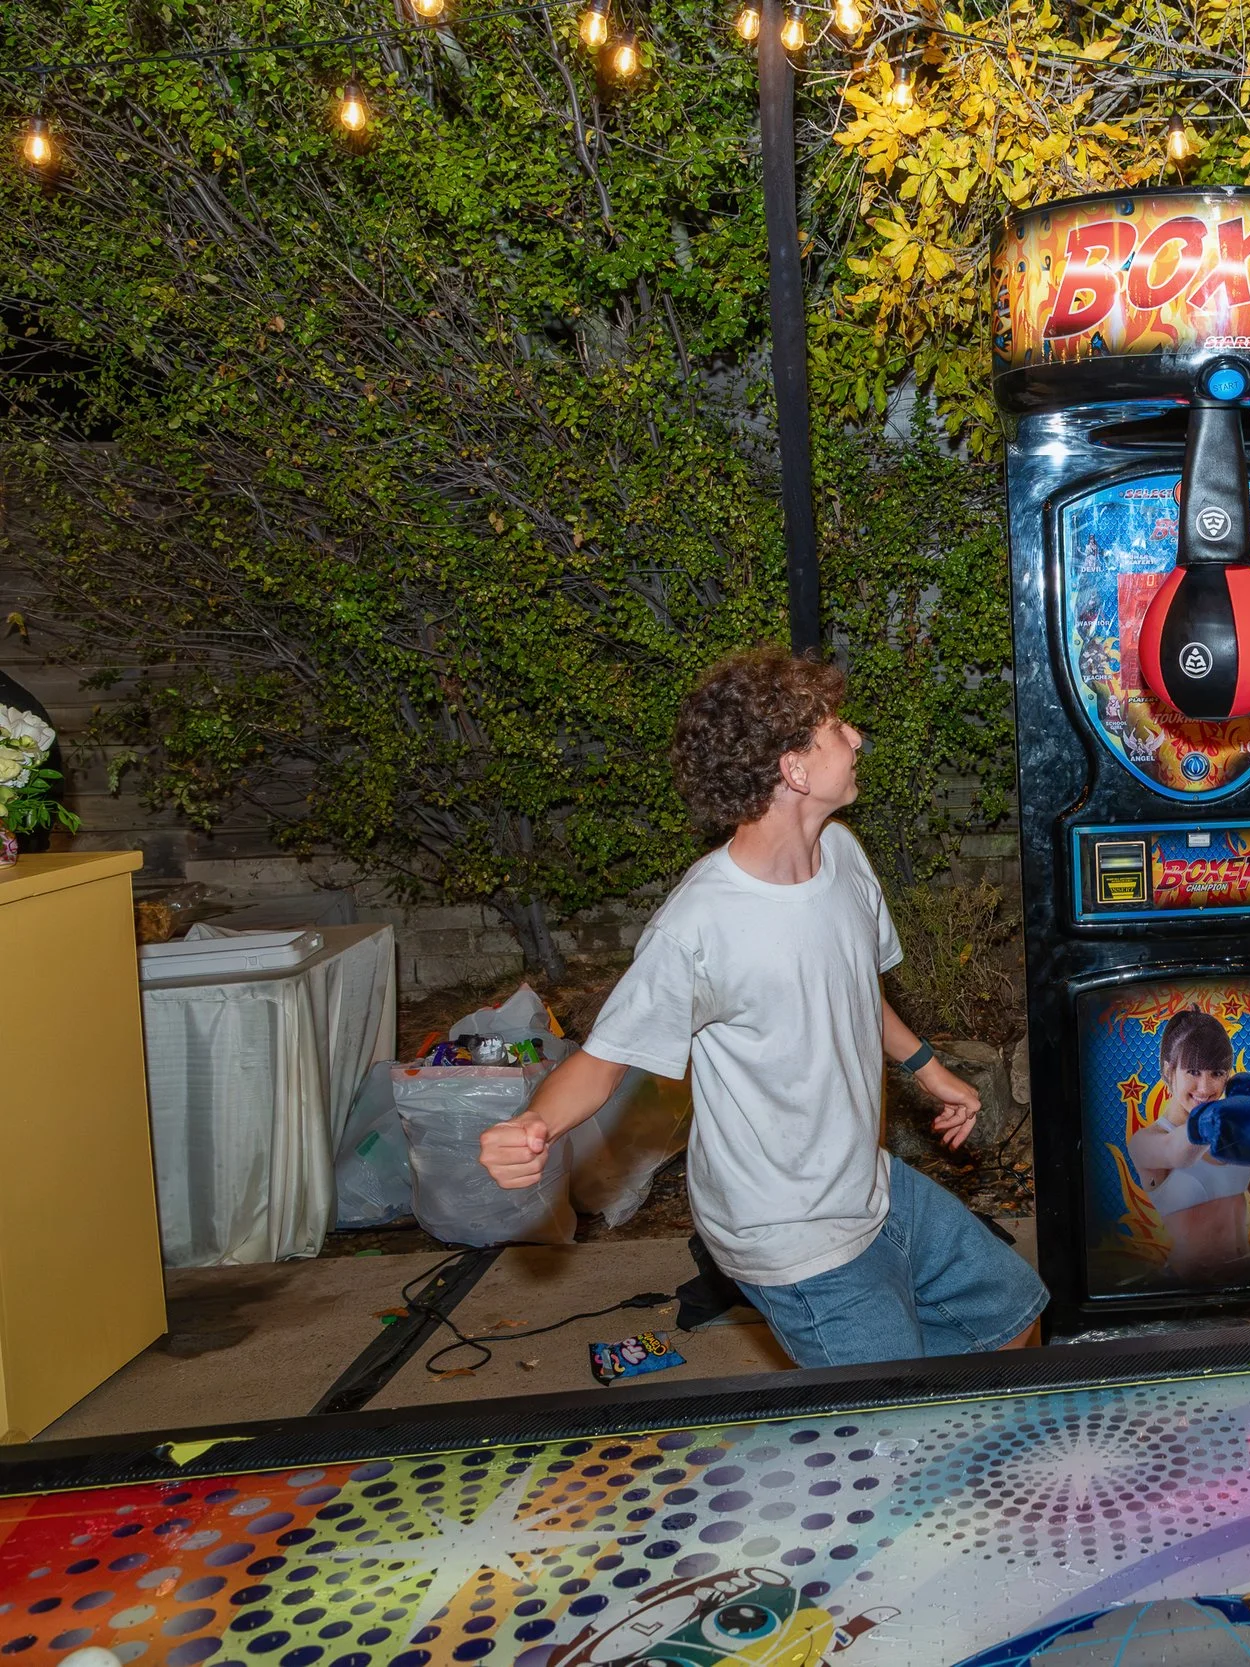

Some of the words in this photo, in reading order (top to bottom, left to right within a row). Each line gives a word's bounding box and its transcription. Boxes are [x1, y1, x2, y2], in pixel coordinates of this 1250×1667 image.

[1213, 381, 1239, 392] START
[1124, 488, 1174, 500] SELECT
[1186, 882, 1228, 892] CHAMPION
